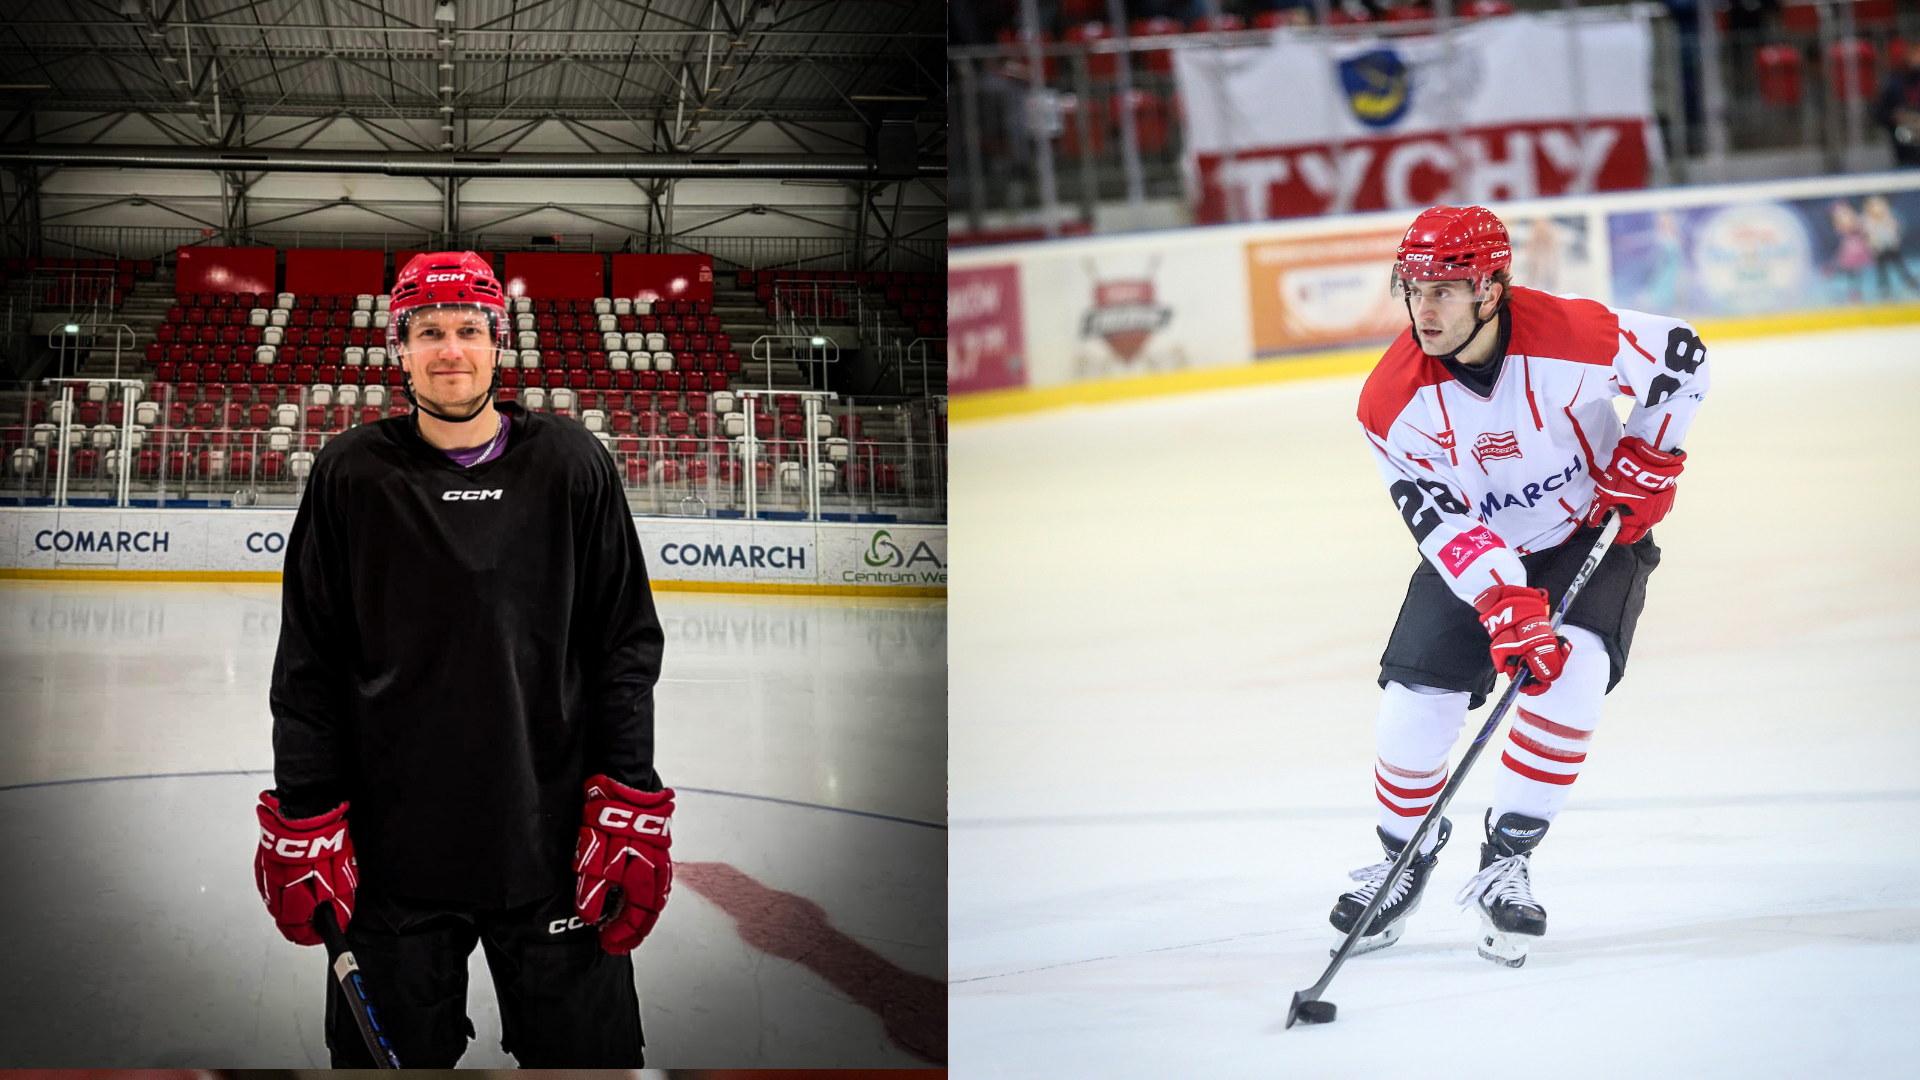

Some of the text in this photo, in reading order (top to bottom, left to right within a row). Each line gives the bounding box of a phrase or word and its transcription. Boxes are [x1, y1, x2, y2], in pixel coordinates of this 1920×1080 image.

[1217, 123, 1621, 222] TYCHY
[1405, 253, 1434, 262] CCM
[1490, 249, 1509, 259] CCM
[425, 273, 466, 283] CCM
[441, 489, 504, 501] CCM
[1479, 454, 1582, 525] MARCH
[1389, 477, 1470, 547] 28
[34, 529, 170, 553] COMARCH
[660, 543, 805, 570] COMARCH
[842, 570, 917, 583] Centrum
[1533, 656, 1551, 675] CCM
[260, 827, 345, 859] CCM
[548, 915, 585, 934] CC
